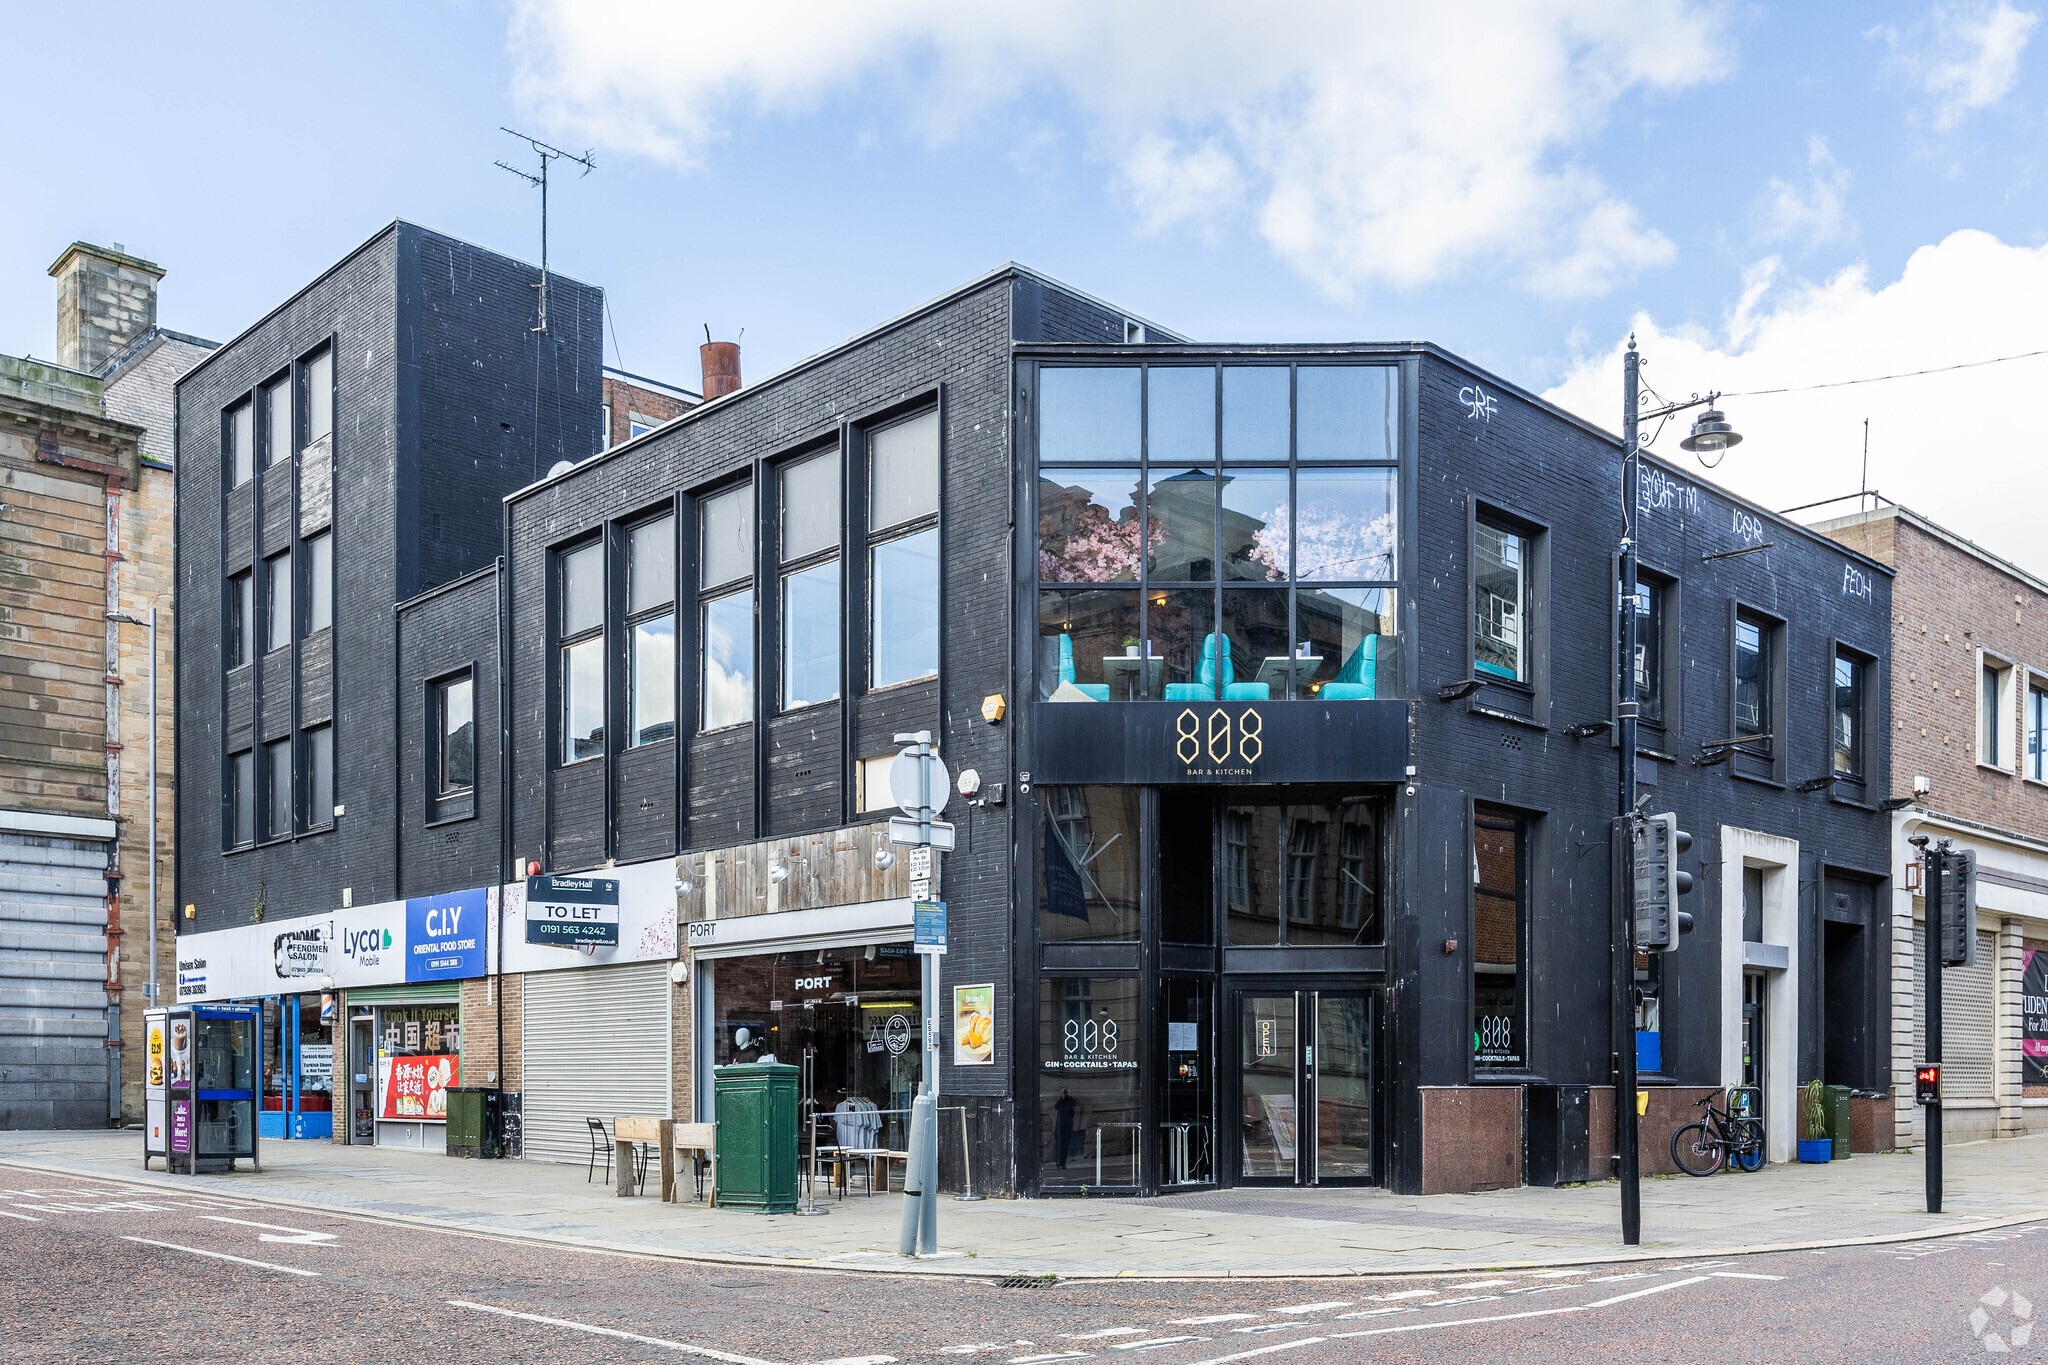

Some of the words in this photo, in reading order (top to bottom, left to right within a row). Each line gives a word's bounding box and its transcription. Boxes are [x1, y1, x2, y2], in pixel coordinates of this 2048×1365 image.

[1177, 707, 1262, 765] 808
[544, 906, 568, 918] TO
[572, 907, 601, 919] LET
[426, 906, 462, 937] C.I.Y
[540, 924, 560, 933] 0191
[562, 925, 580, 934] 563
[582, 926, 606, 935] 4242
[690, 922, 717, 937] PORT
[292, 944, 329, 953] FENOMEN
[344, 927, 380, 959] Lyca
[413, 942, 440, 955] ORIENTAL
[440, 941, 457, 952] FOOD
[457, 939, 476, 950] STORE
[292, 952, 318, 960] SALON
[359, 954, 380, 966] Mobile
[795, 976, 832, 990] PORT
[965, 994, 985, 1003] Brunch
[384, 1009, 407, 1024] Cook
[2028, 1016, 2039, 1032] For
[385, 1019, 459, 1053] 中国超市
[1064, 1019, 1117, 1053] 808
[1262, 1022, 1270, 1055] OPEN
[1482, 1015, 1511, 1048] 808
[1742, 1095, 1748, 1105] P
